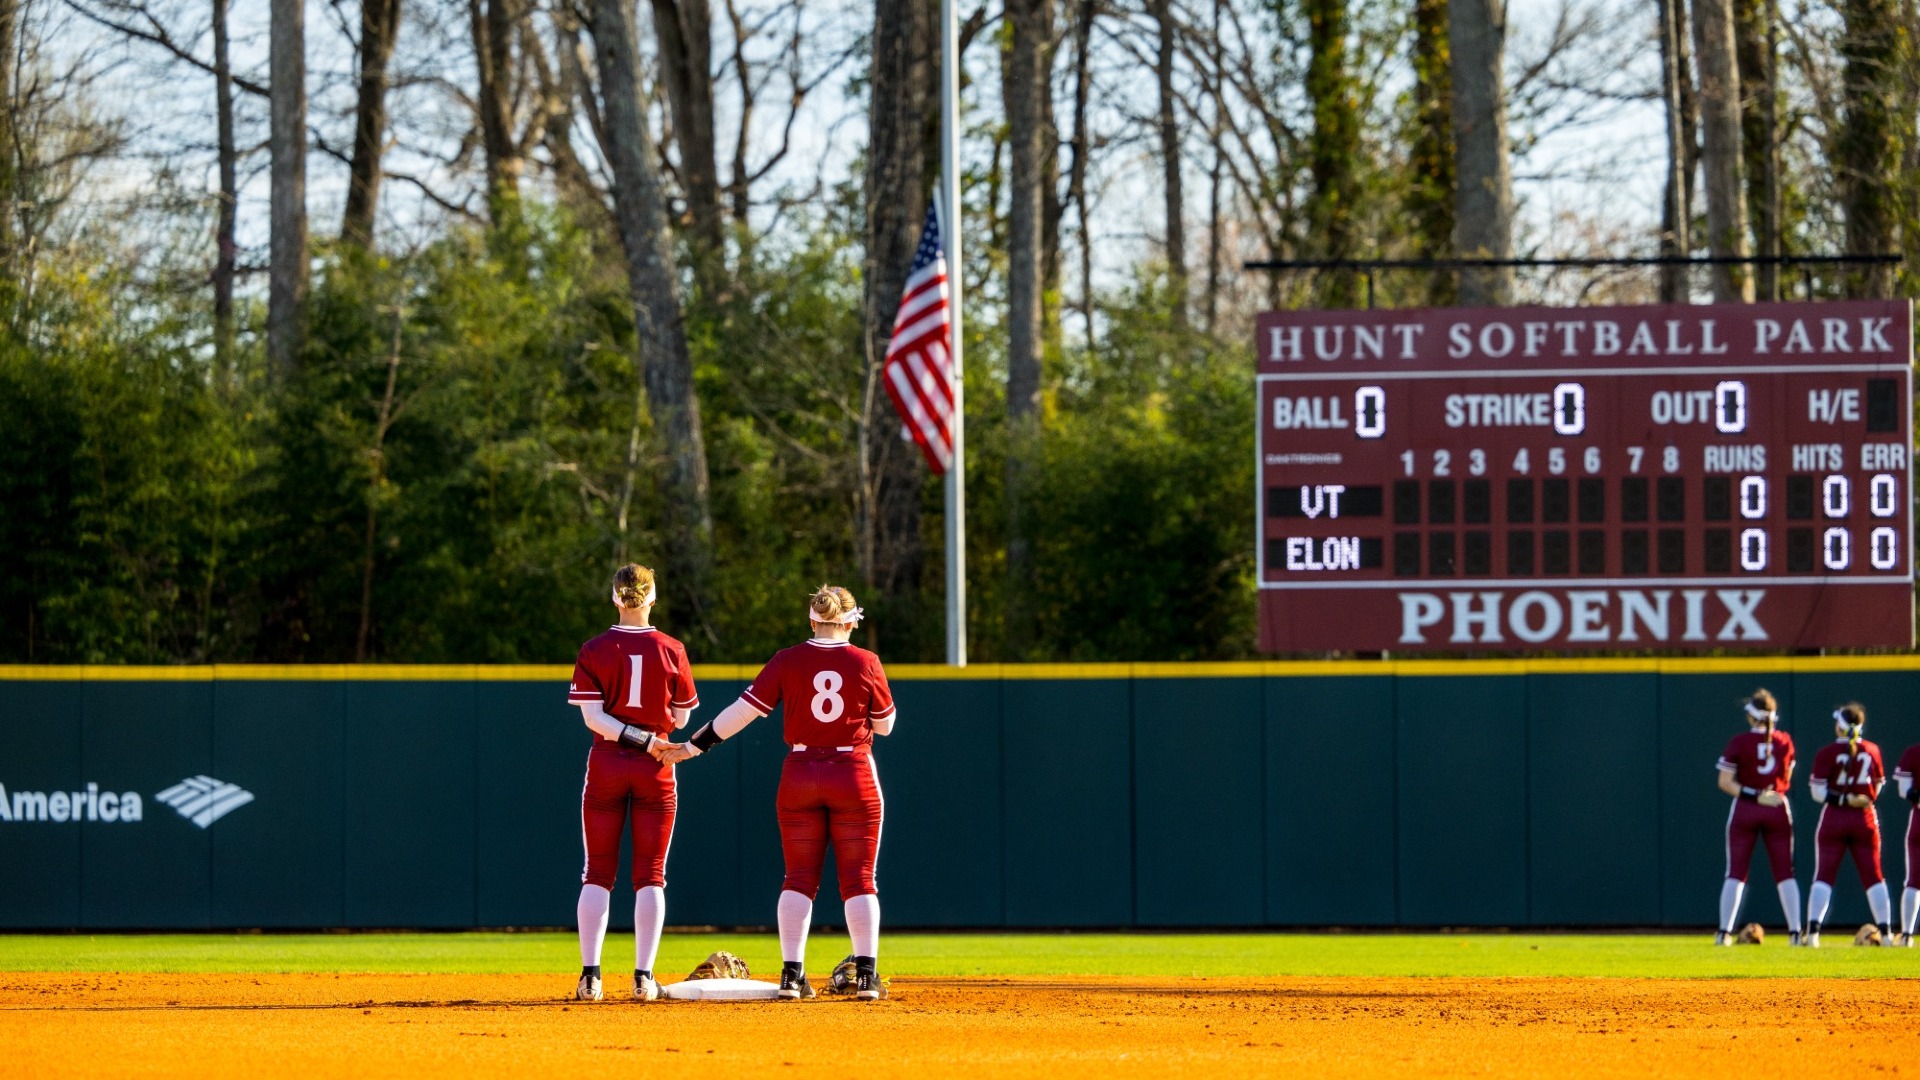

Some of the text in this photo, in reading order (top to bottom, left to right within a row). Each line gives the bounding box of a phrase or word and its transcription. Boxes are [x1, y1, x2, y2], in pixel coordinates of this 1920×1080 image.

[1269, 317, 1894, 361] HUNT SOFTBALL PARK
[1273, 386, 1386, 438] BALL 0
[1445, 382, 1585, 435] STRIKE 0
[1651, 380, 1746, 433] OUT 0
[1808, 388, 1860, 424] H/E
[1401, 443, 1906, 476] 1 2 3 4 5 6 7 8 RUNS HITS ERR
[1301, 473, 1897, 519] VT 0 0 0
[1286, 526, 1897, 571] ELON 0 0 0
[1398, 590, 1770, 643] PHOENIX
[625, 654, 643, 708] 1
[810, 670, 845, 723] 8
[1757, 742, 1776, 775] 5
[1836, 752, 1873, 785] 22
